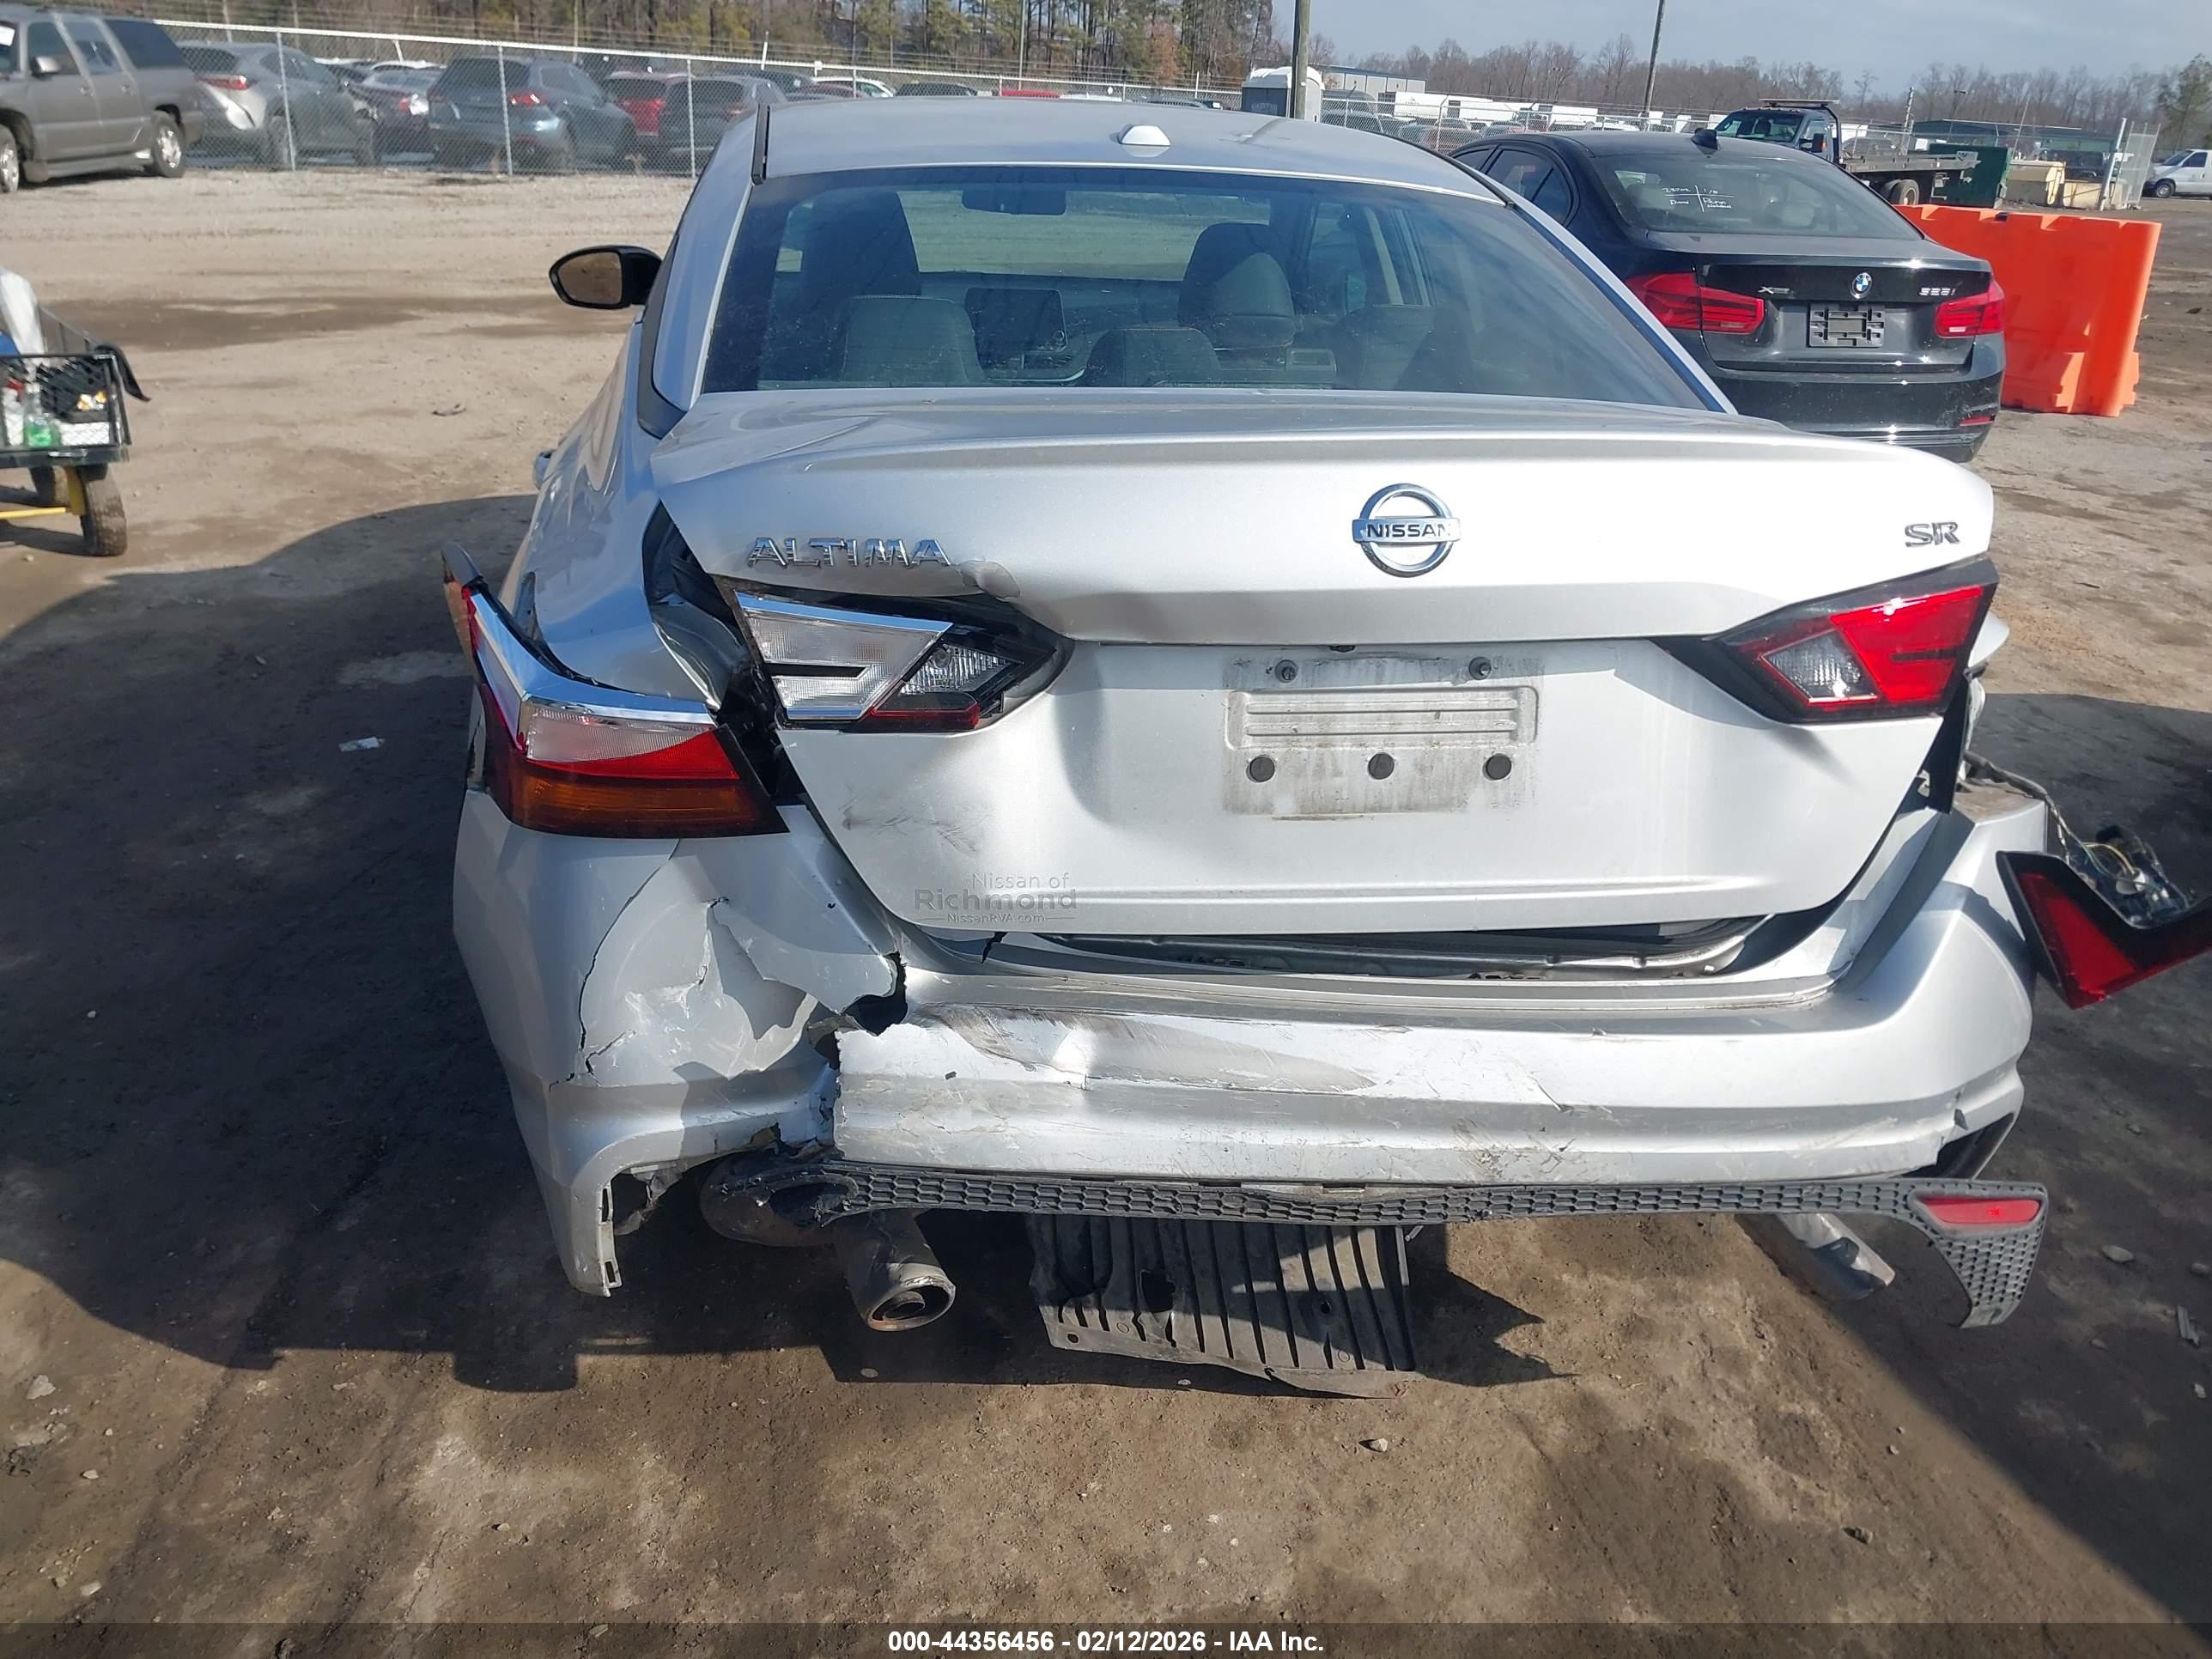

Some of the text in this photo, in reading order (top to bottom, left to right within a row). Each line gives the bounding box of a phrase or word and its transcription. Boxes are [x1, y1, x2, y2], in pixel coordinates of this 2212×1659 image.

[1366, 523, 1452, 538] NISSAN
[1905, 521, 1960, 547] SR
[747, 537, 952, 568] ALTIMA
[972, 872, 1070, 890] Nissan of
[914, 888, 1078, 911] Richmond
[947, 913, 1046, 924] NissanRVAcom
